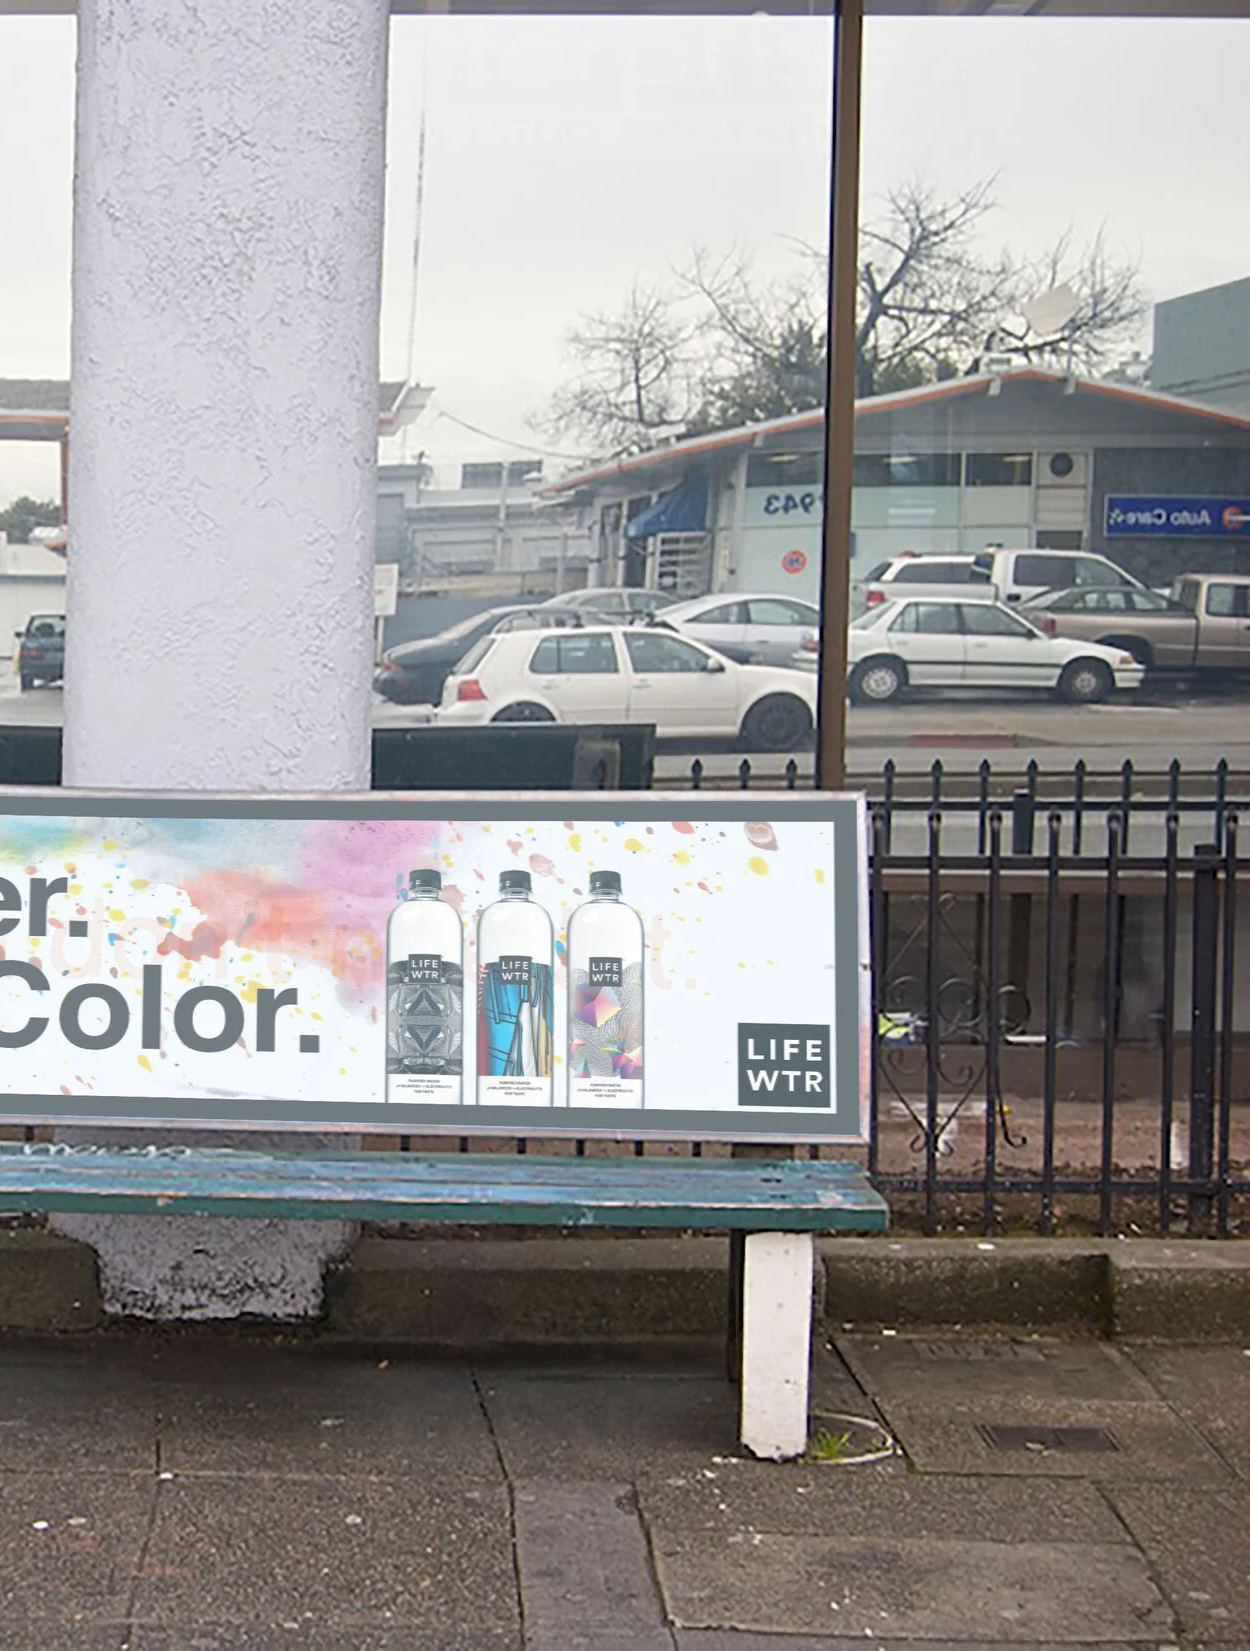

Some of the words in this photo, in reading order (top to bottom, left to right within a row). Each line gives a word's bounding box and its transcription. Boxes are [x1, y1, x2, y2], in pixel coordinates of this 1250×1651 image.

[411, 959, 439, 969] LIFE
[501, 960, 530, 970] LIFE
[591, 962, 620, 972] LIFE
[410, 970, 439, 980] WTR
[501, 971, 530, 981] WTR
[591, 973, 621, 983] WTR
[747, 1038, 823, 1062] LIFE
[746, 1069, 823, 1093] WTR
